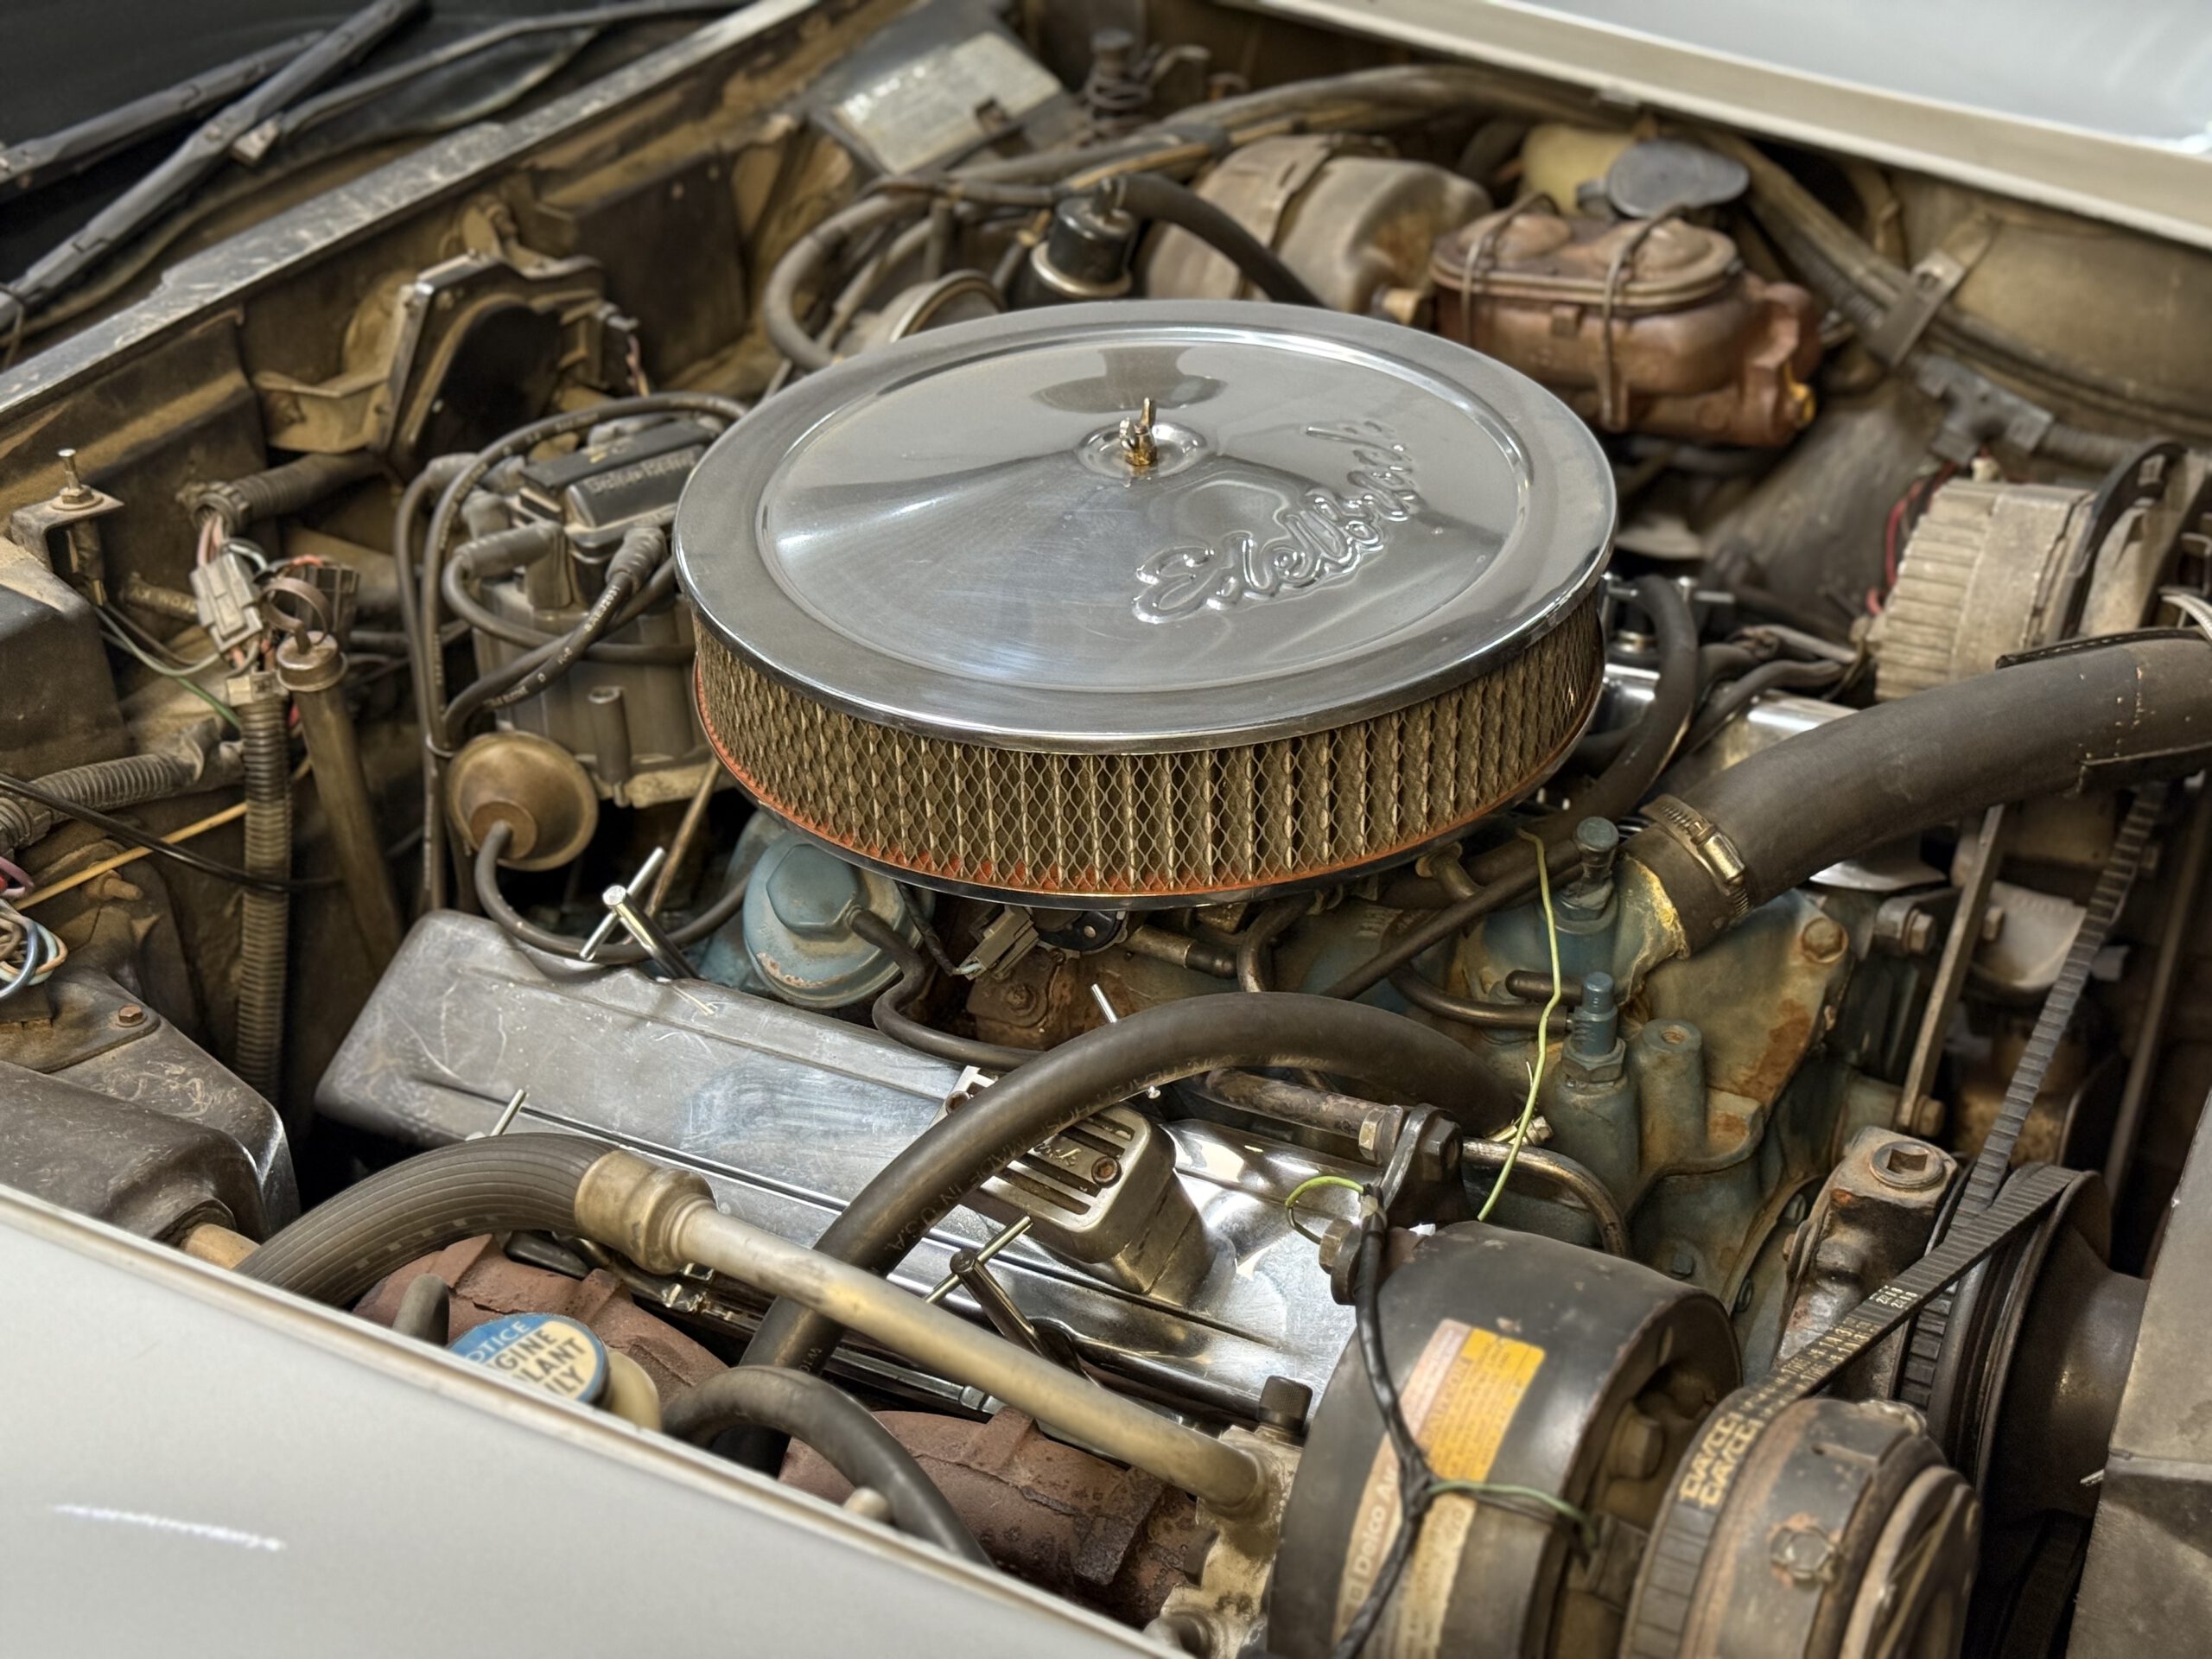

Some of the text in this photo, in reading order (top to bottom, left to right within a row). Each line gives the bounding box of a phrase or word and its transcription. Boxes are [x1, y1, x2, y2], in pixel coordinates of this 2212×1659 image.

[466, 1320, 531, 1363] OTICE
[486, 1328, 556, 1371] GINE
[513, 1337, 587, 1382] LANT
[1354, 1505, 1386, 1577] Delco
